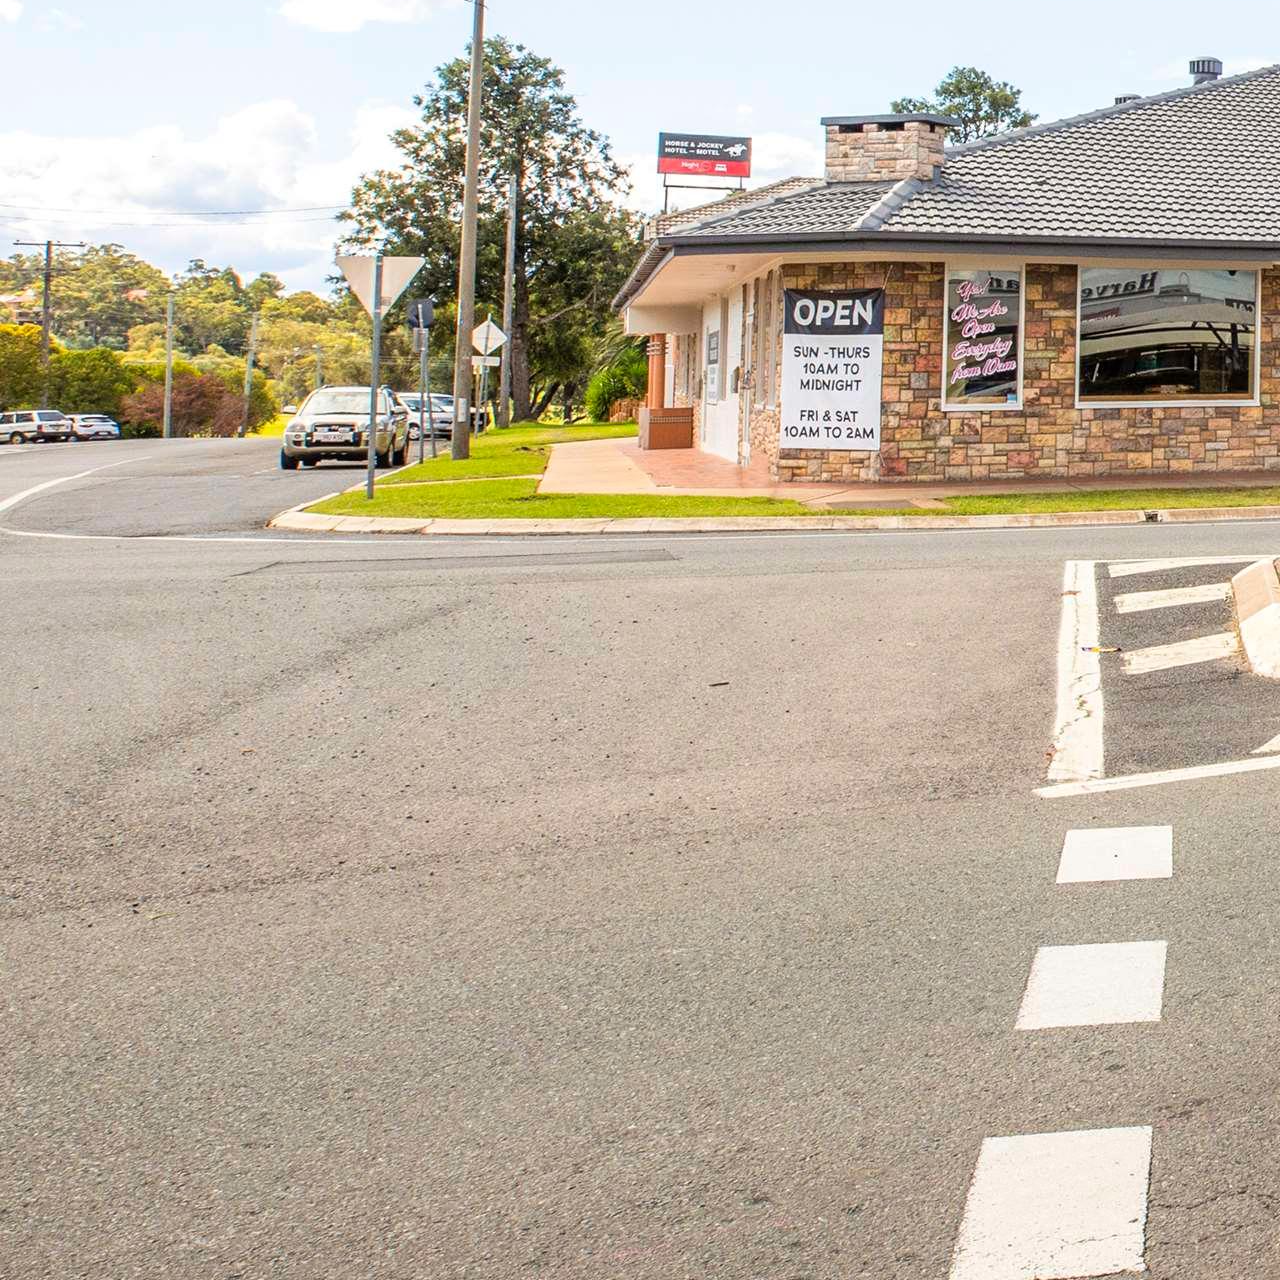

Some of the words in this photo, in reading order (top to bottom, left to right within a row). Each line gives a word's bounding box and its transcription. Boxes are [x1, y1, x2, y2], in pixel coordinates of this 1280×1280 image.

[696, 148, 720, 156] MOTEL
[794, 298, 873, 326] OPEN
[962, 319, 996, 338] Open
[793, 346, 819, 358] SUN
[803, 363, 838, 375] 10AM
[843, 363, 860, 375] TO
[951, 362, 981, 384] from
[982, 357, 1017, 376] 10am
[800, 379, 862, 391] MIDNIGHT
[799, 410, 819, 422] FRI
[822, 410, 832, 422] &
[836, 410, 859, 422] SAT
[784, 426, 820, 438] 10AM
[824, 426, 842, 439] TO
[846, 427, 875, 439] 2AM
